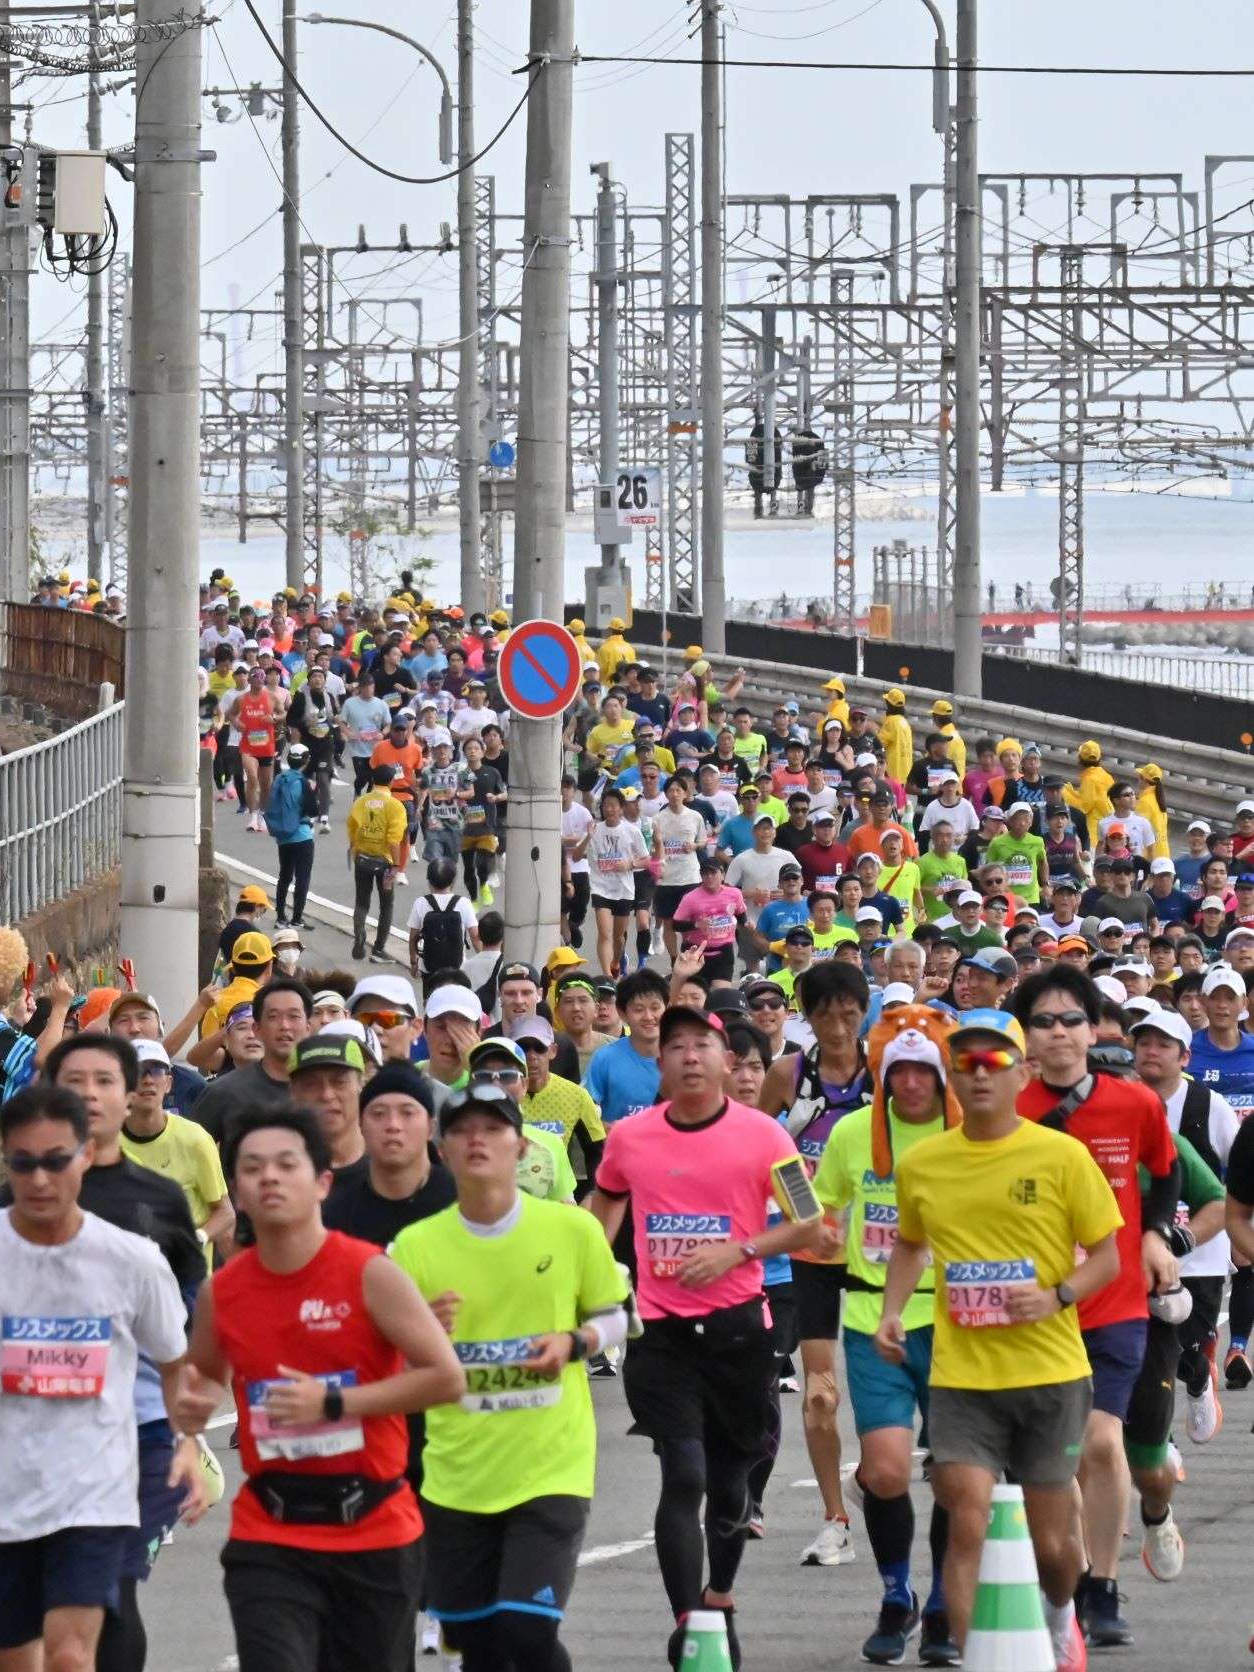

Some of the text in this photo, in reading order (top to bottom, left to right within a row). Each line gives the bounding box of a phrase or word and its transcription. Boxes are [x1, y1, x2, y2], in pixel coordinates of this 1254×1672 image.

[617, 474, 648, 509] 26
[802, 1139, 826, 1154] シス
[650, 1215, 722, 1232] シスメックス
[952, 1262, 1025, 1280] シスメックス
[11, 1319, 102, 1339] シスメックス
[27, 1348, 89, 1369] Mikky
